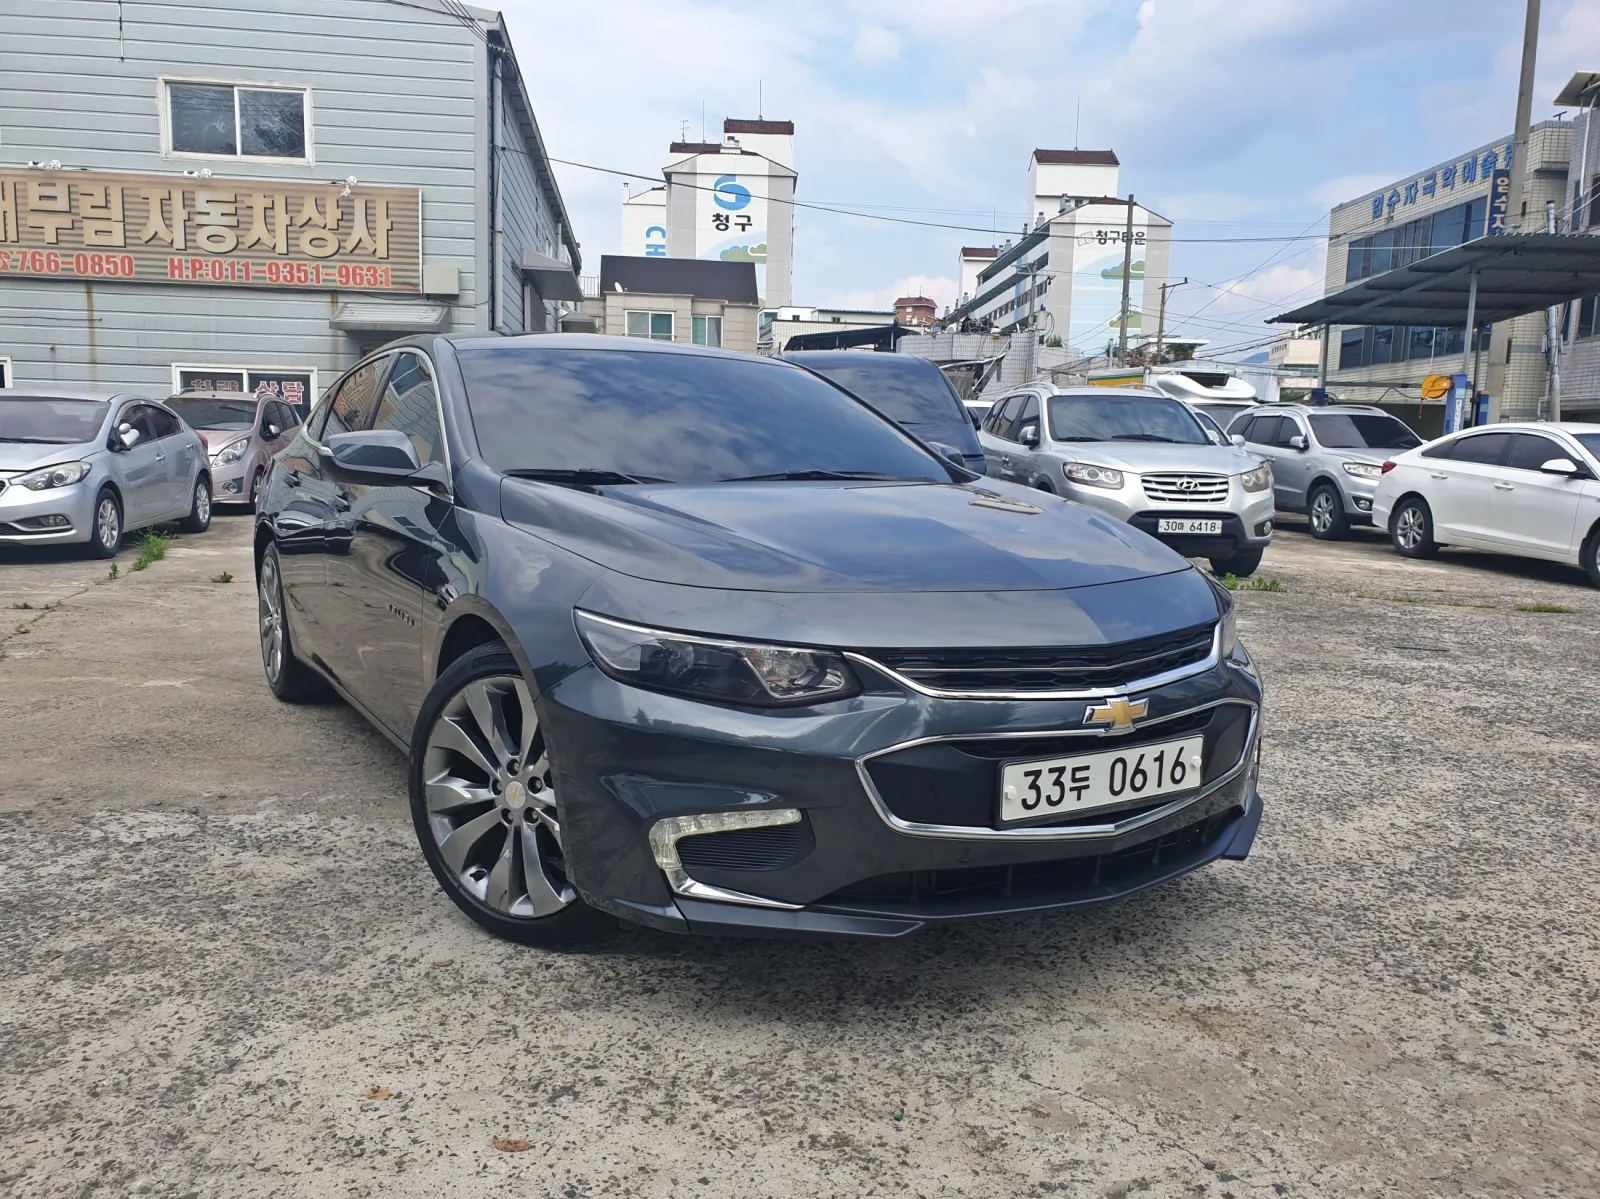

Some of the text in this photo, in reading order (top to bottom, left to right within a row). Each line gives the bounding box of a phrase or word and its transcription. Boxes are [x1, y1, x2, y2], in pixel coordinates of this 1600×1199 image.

[711, 212, 753, 233] 청구
[15, 250, 135, 278] 766-0850
[1189, 521, 1217, 532] 6418
[1021, 764, 1091, 811] 33두
[1108, 746, 1187, 797] 0616
